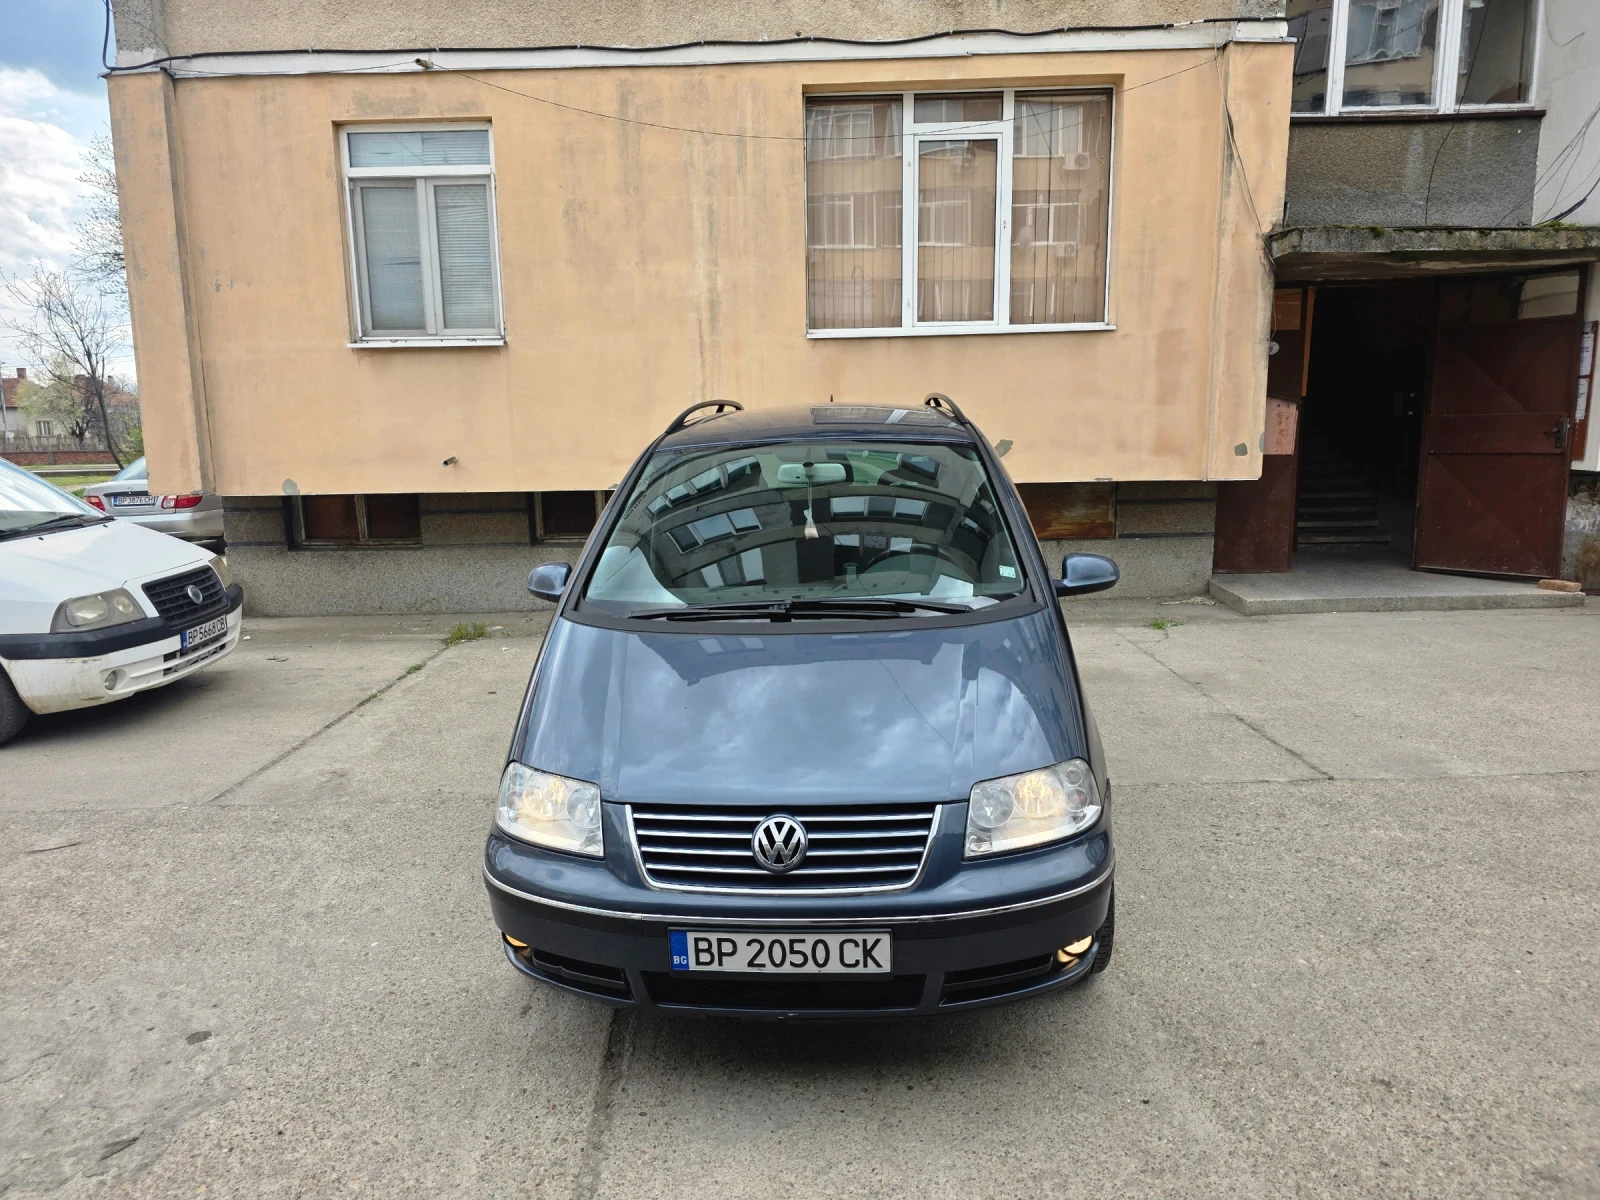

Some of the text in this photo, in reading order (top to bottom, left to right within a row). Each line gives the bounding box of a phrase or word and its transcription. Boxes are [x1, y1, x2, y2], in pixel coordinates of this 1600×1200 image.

[188, 629, 199, 645] BP
[199, 621, 216, 640] 5668
[753, 816, 807, 871] VW
[673, 956, 687, 965] BG
[693, 937, 884, 968] BP 2050 CK
